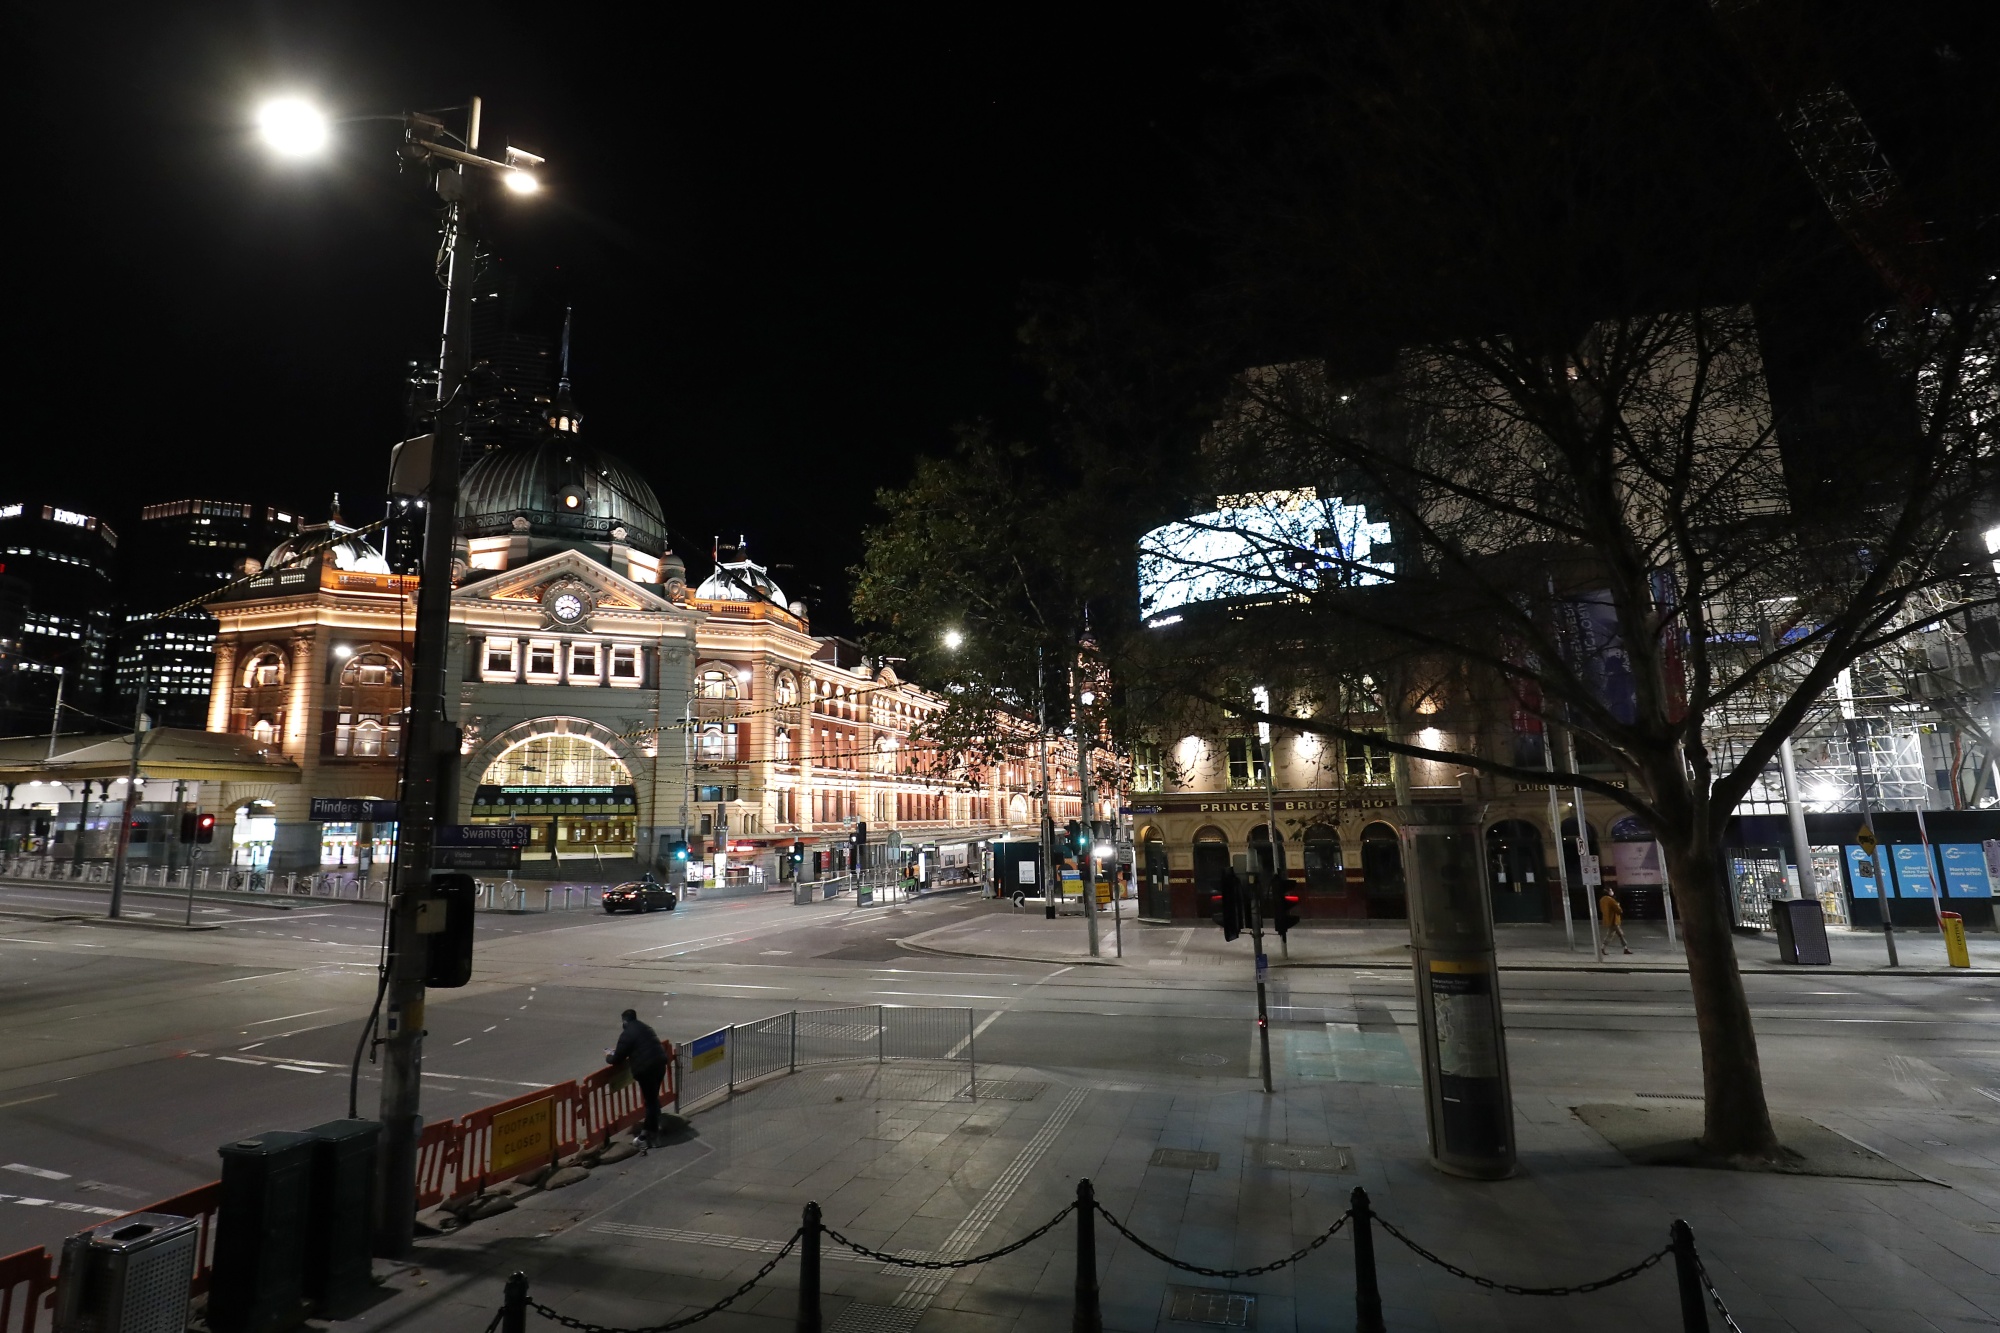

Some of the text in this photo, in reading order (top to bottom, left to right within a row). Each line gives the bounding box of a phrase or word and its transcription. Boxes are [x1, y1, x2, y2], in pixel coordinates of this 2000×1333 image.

[314, 799, 373, 813] Flinders St
[1200, 799, 1399, 812] PRINCE'S BRIDGE HOT
[462, 826, 528, 839] Swanston St
[498, 1112, 546, 1135] FOOTPATH
[504, 1132, 541, 1155] CLOSED
